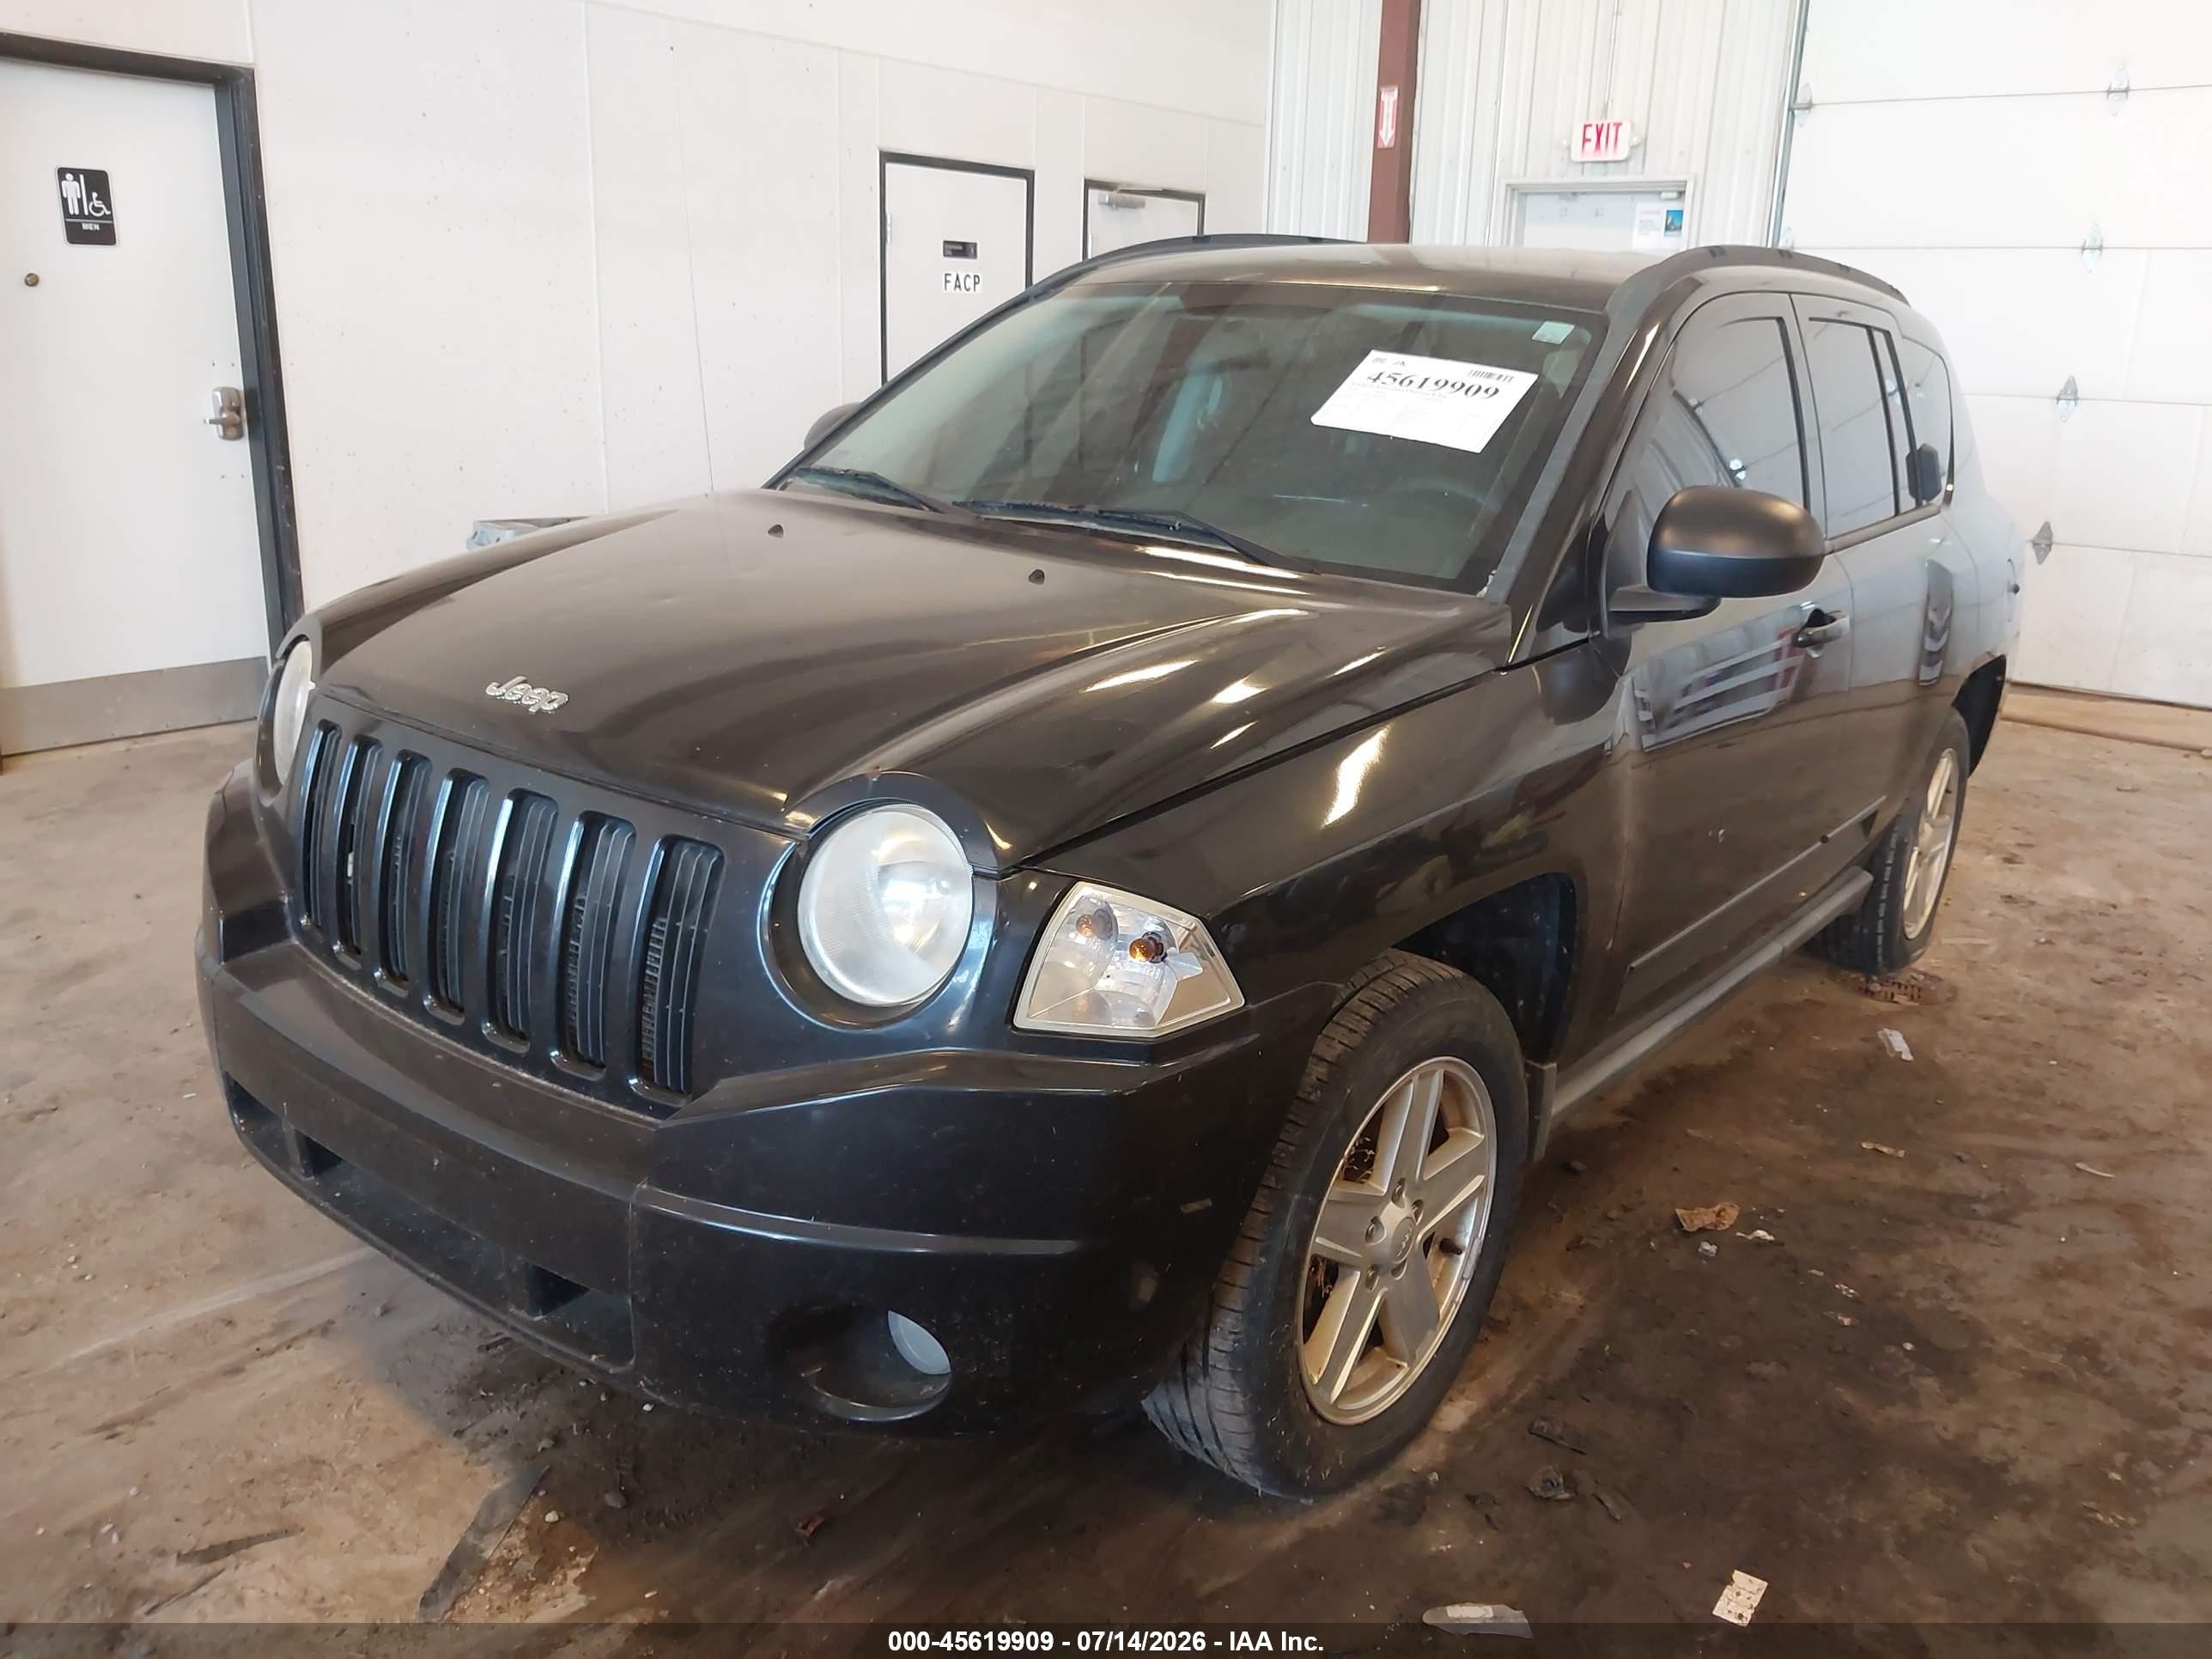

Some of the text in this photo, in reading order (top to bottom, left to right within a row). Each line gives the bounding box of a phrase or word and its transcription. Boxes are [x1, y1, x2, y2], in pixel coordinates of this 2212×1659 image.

[1581, 122, 1623, 155] EXIT
[82, 222, 100, 231] MEN
[944, 272, 981, 292] FACP
[1367, 370, 1500, 399] 45619909
[485, 675, 569, 713] Jeep
